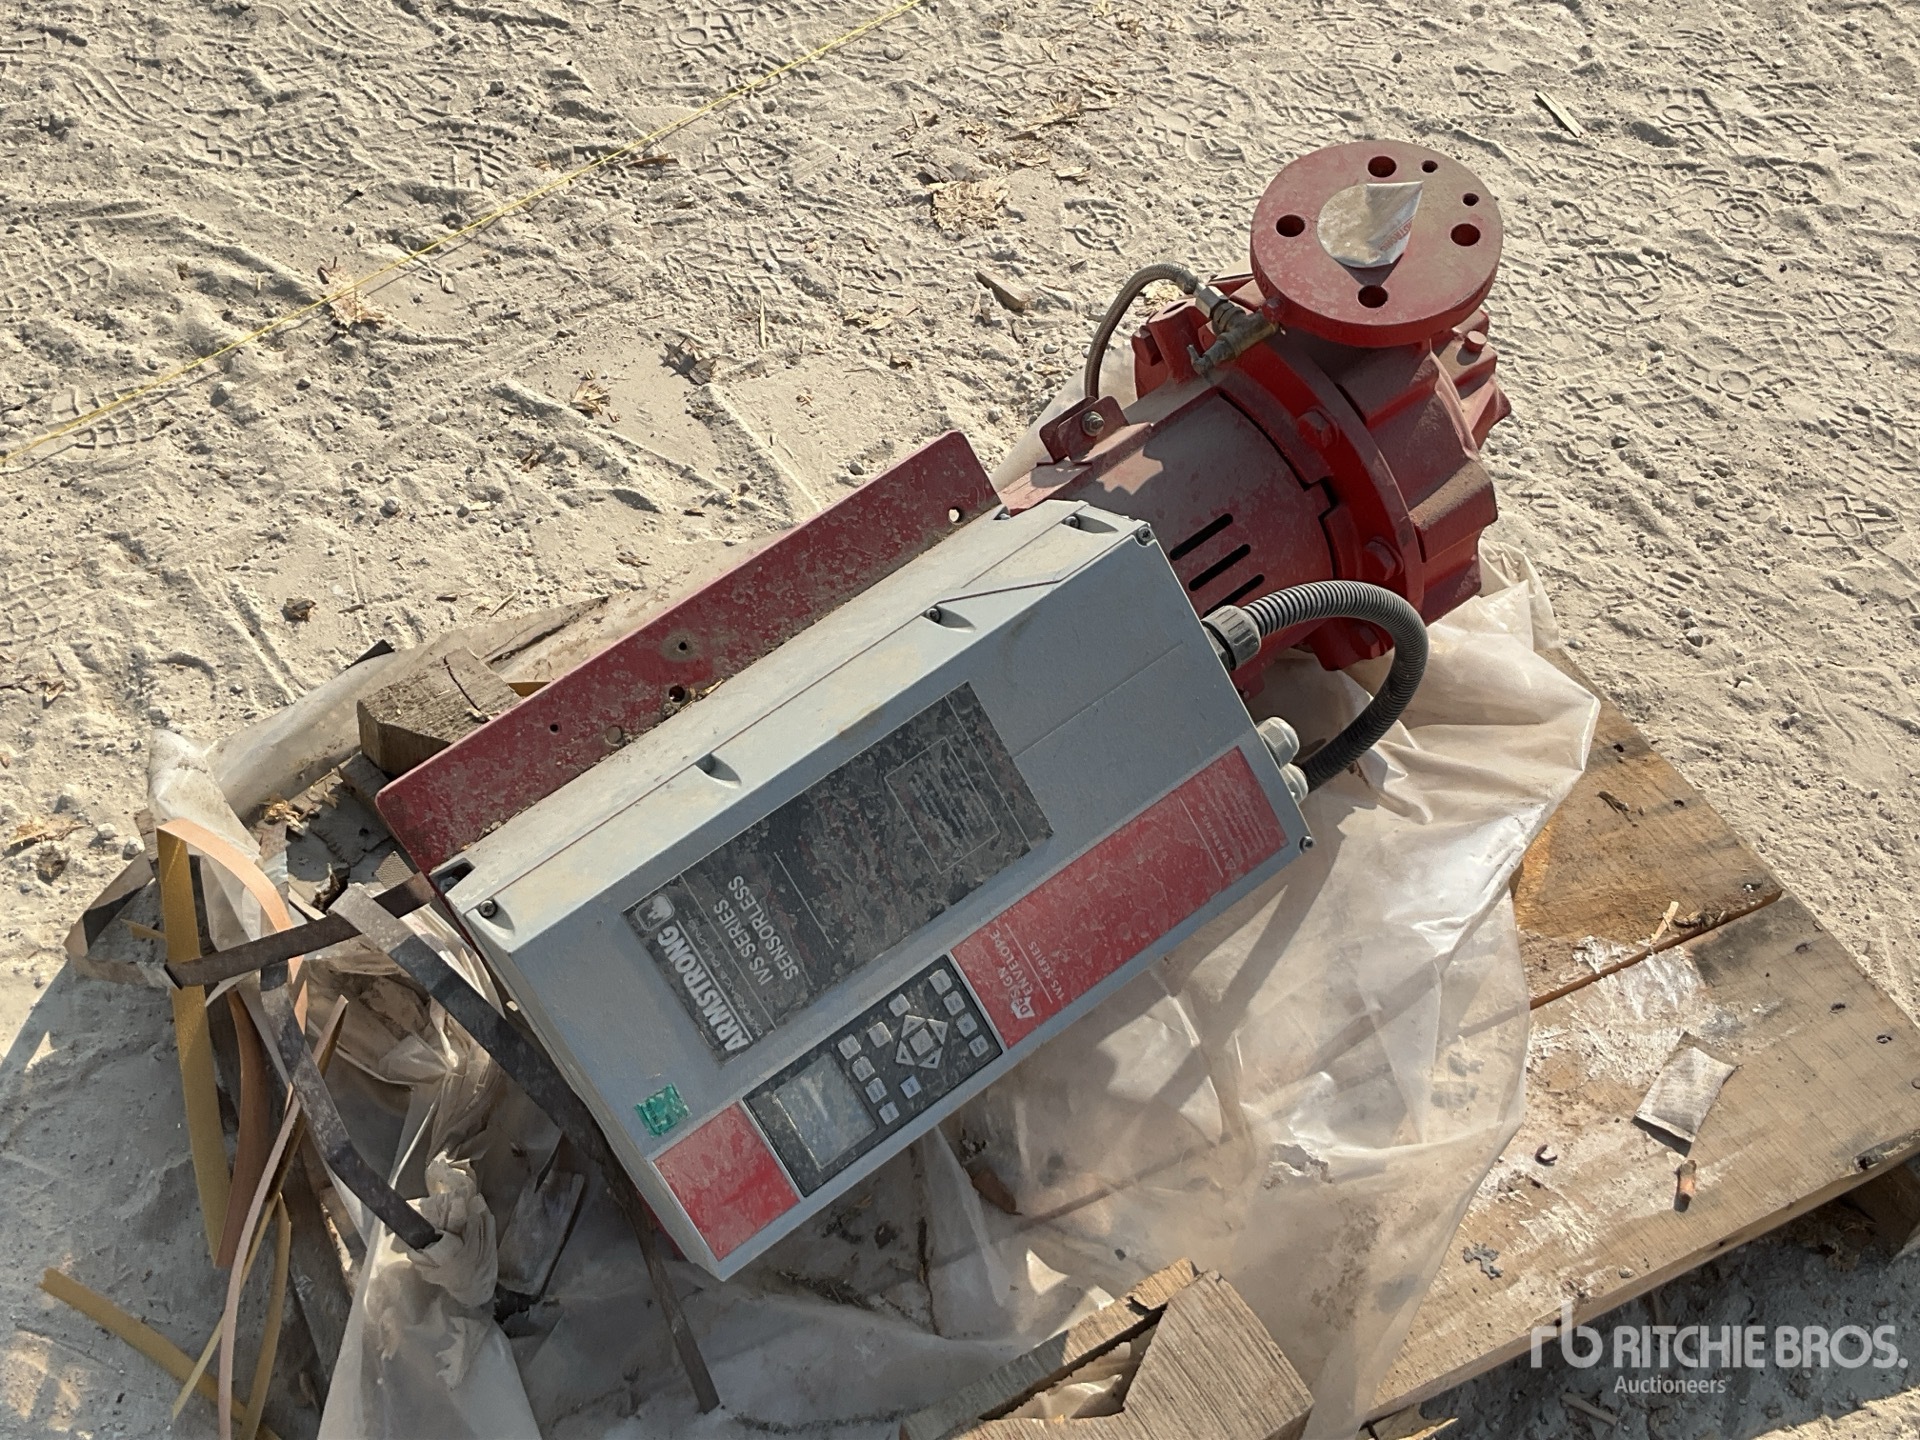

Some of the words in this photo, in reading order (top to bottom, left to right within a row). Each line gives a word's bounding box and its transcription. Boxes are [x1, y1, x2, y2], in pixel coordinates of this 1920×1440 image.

[713, 899, 756, 958] SERIES
[728, 875, 799, 980] SENSORLESS
[657, 925, 749, 1051] ARMSTRONG
[749, 956, 774, 986] IVS
[990, 929, 1033, 996] ENVELOPE
[1028, 941, 1054, 979] SERIES
[1050, 980, 1065, 1001] IVS
